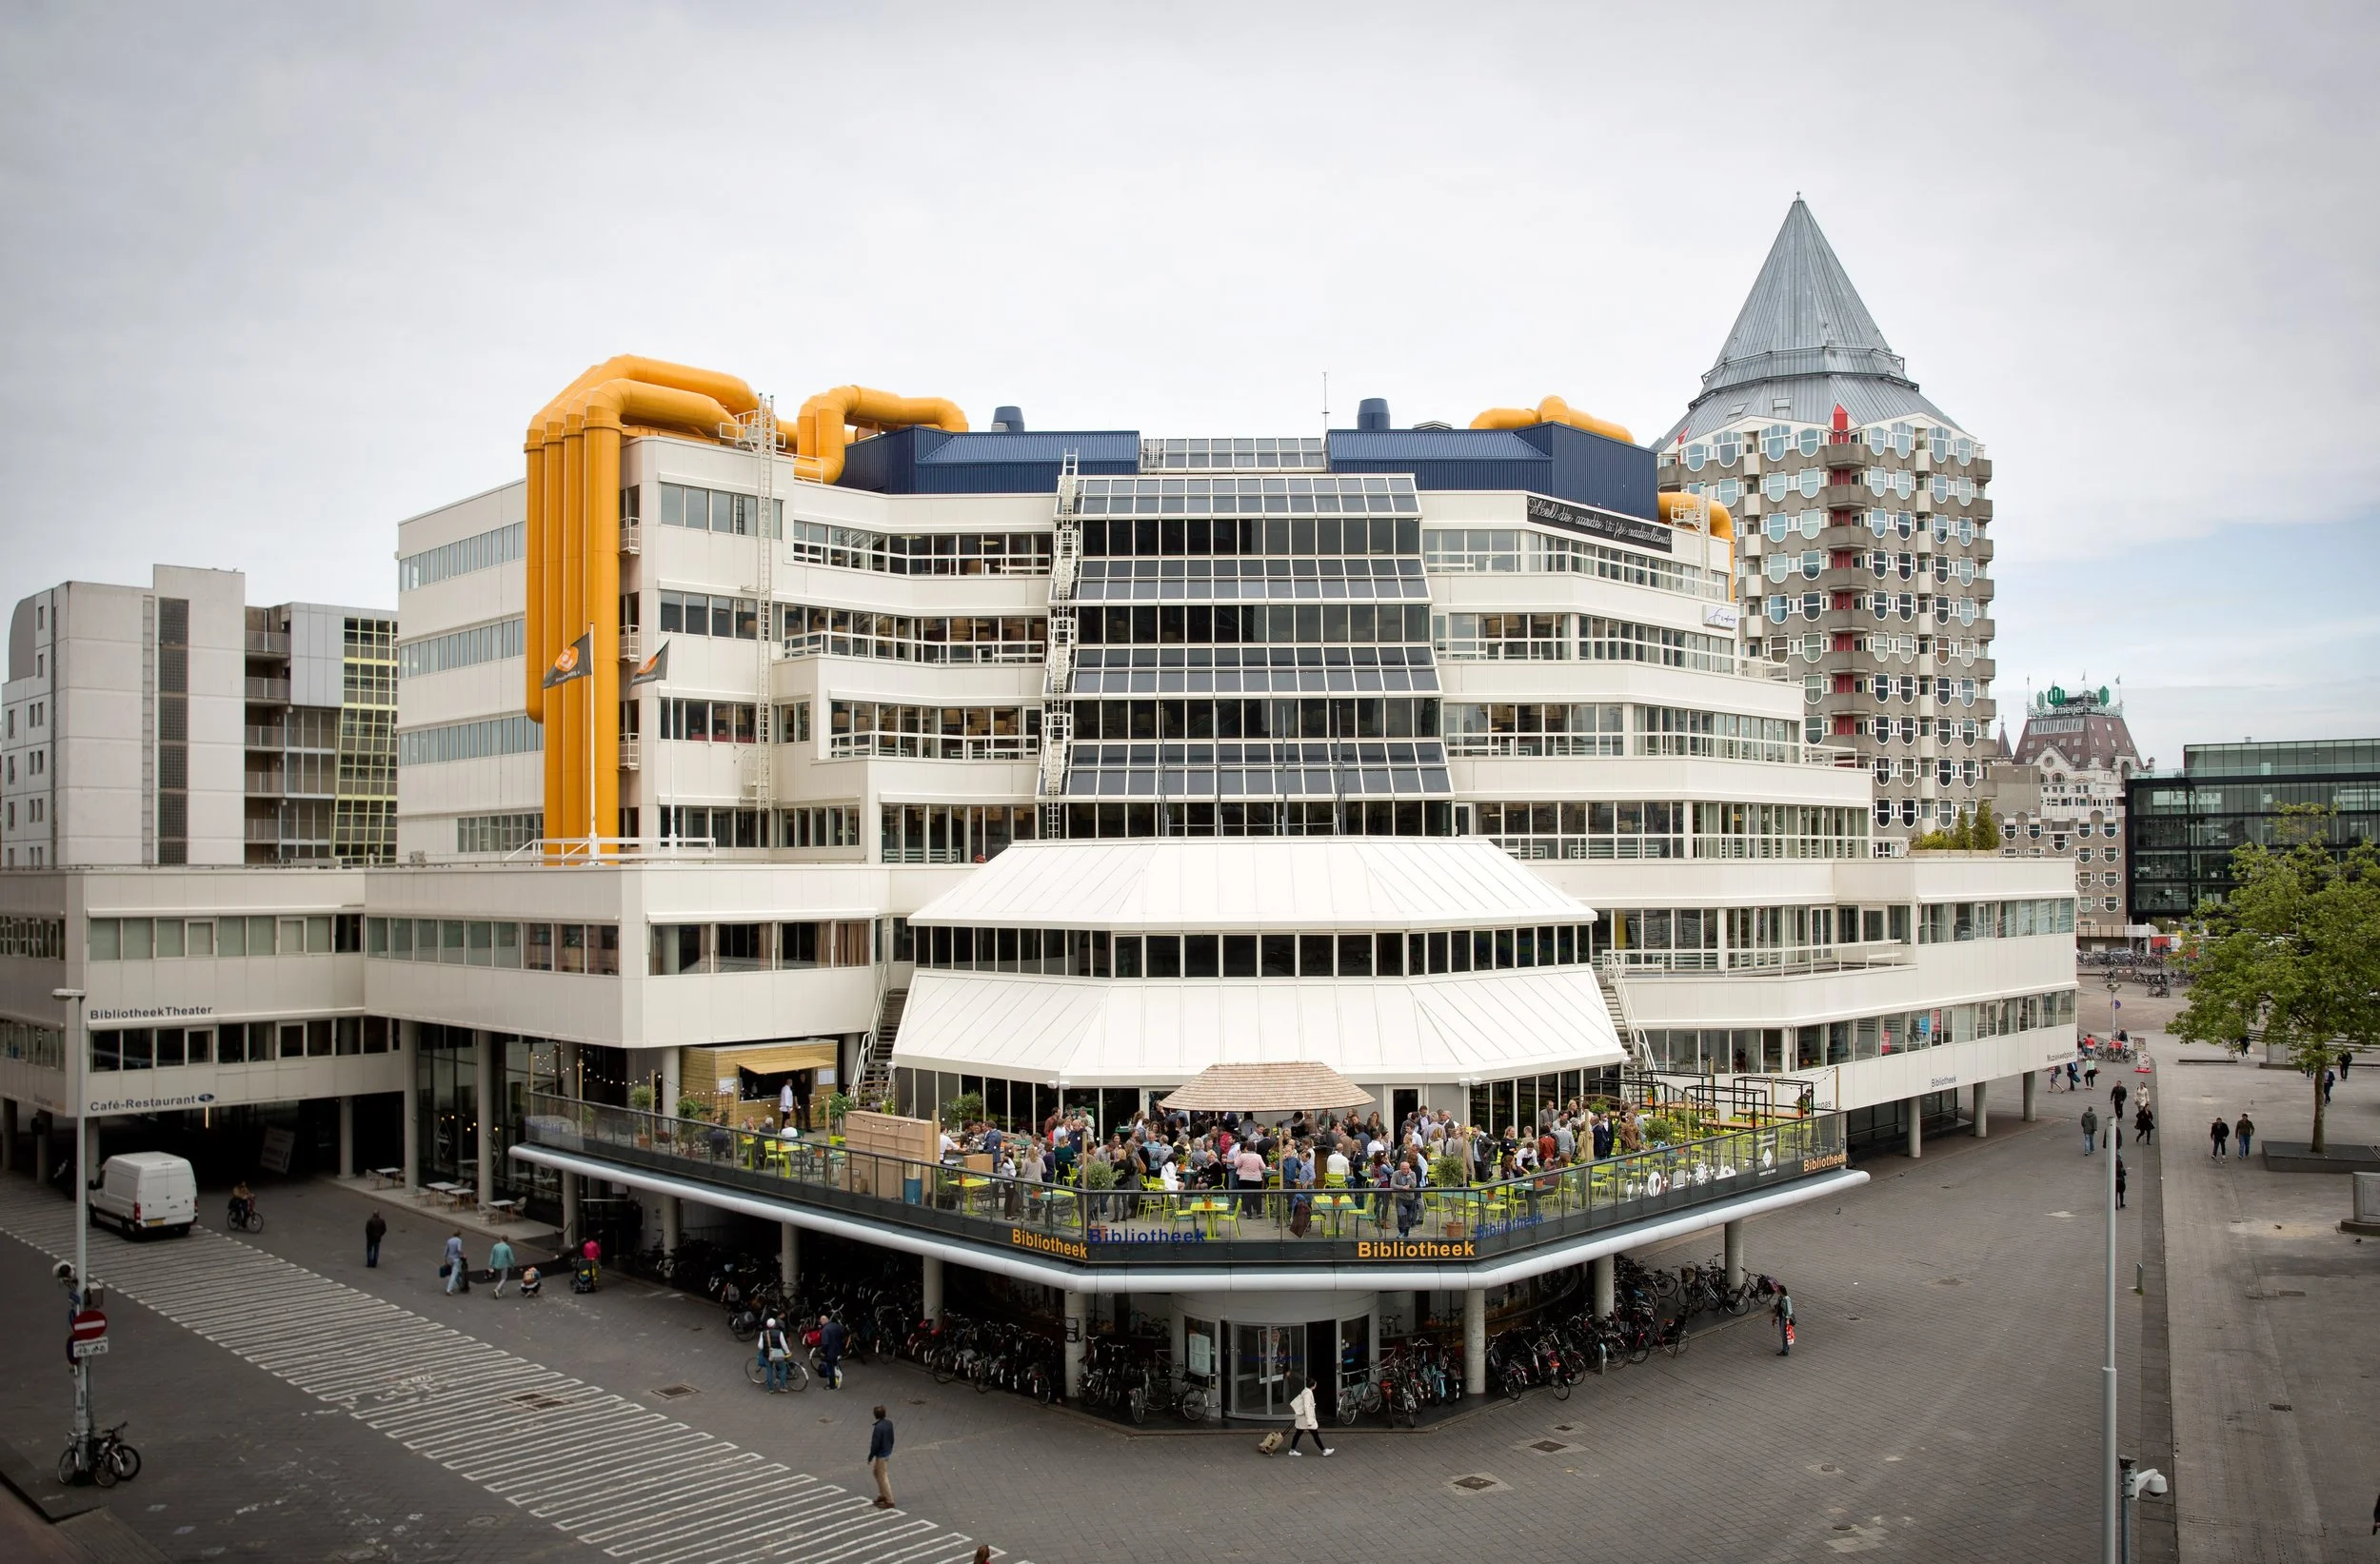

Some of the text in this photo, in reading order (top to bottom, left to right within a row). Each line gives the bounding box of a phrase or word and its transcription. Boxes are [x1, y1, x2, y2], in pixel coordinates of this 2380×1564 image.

[1931, 1076, 1957, 1088] Bibliotheek
[89, 1095, 196, 1112] Café-Restaurant
[1803, 1150, 1847, 1173] Bibliotheek
[1476, 1211, 1544, 1239] Bibliotheek
[1012, 1228, 1088, 1259] Bibliotheek
[1088, 1228, 1205, 1244] Bibliotheek
[1358, 1240, 1475, 1258] Bibliotheek
